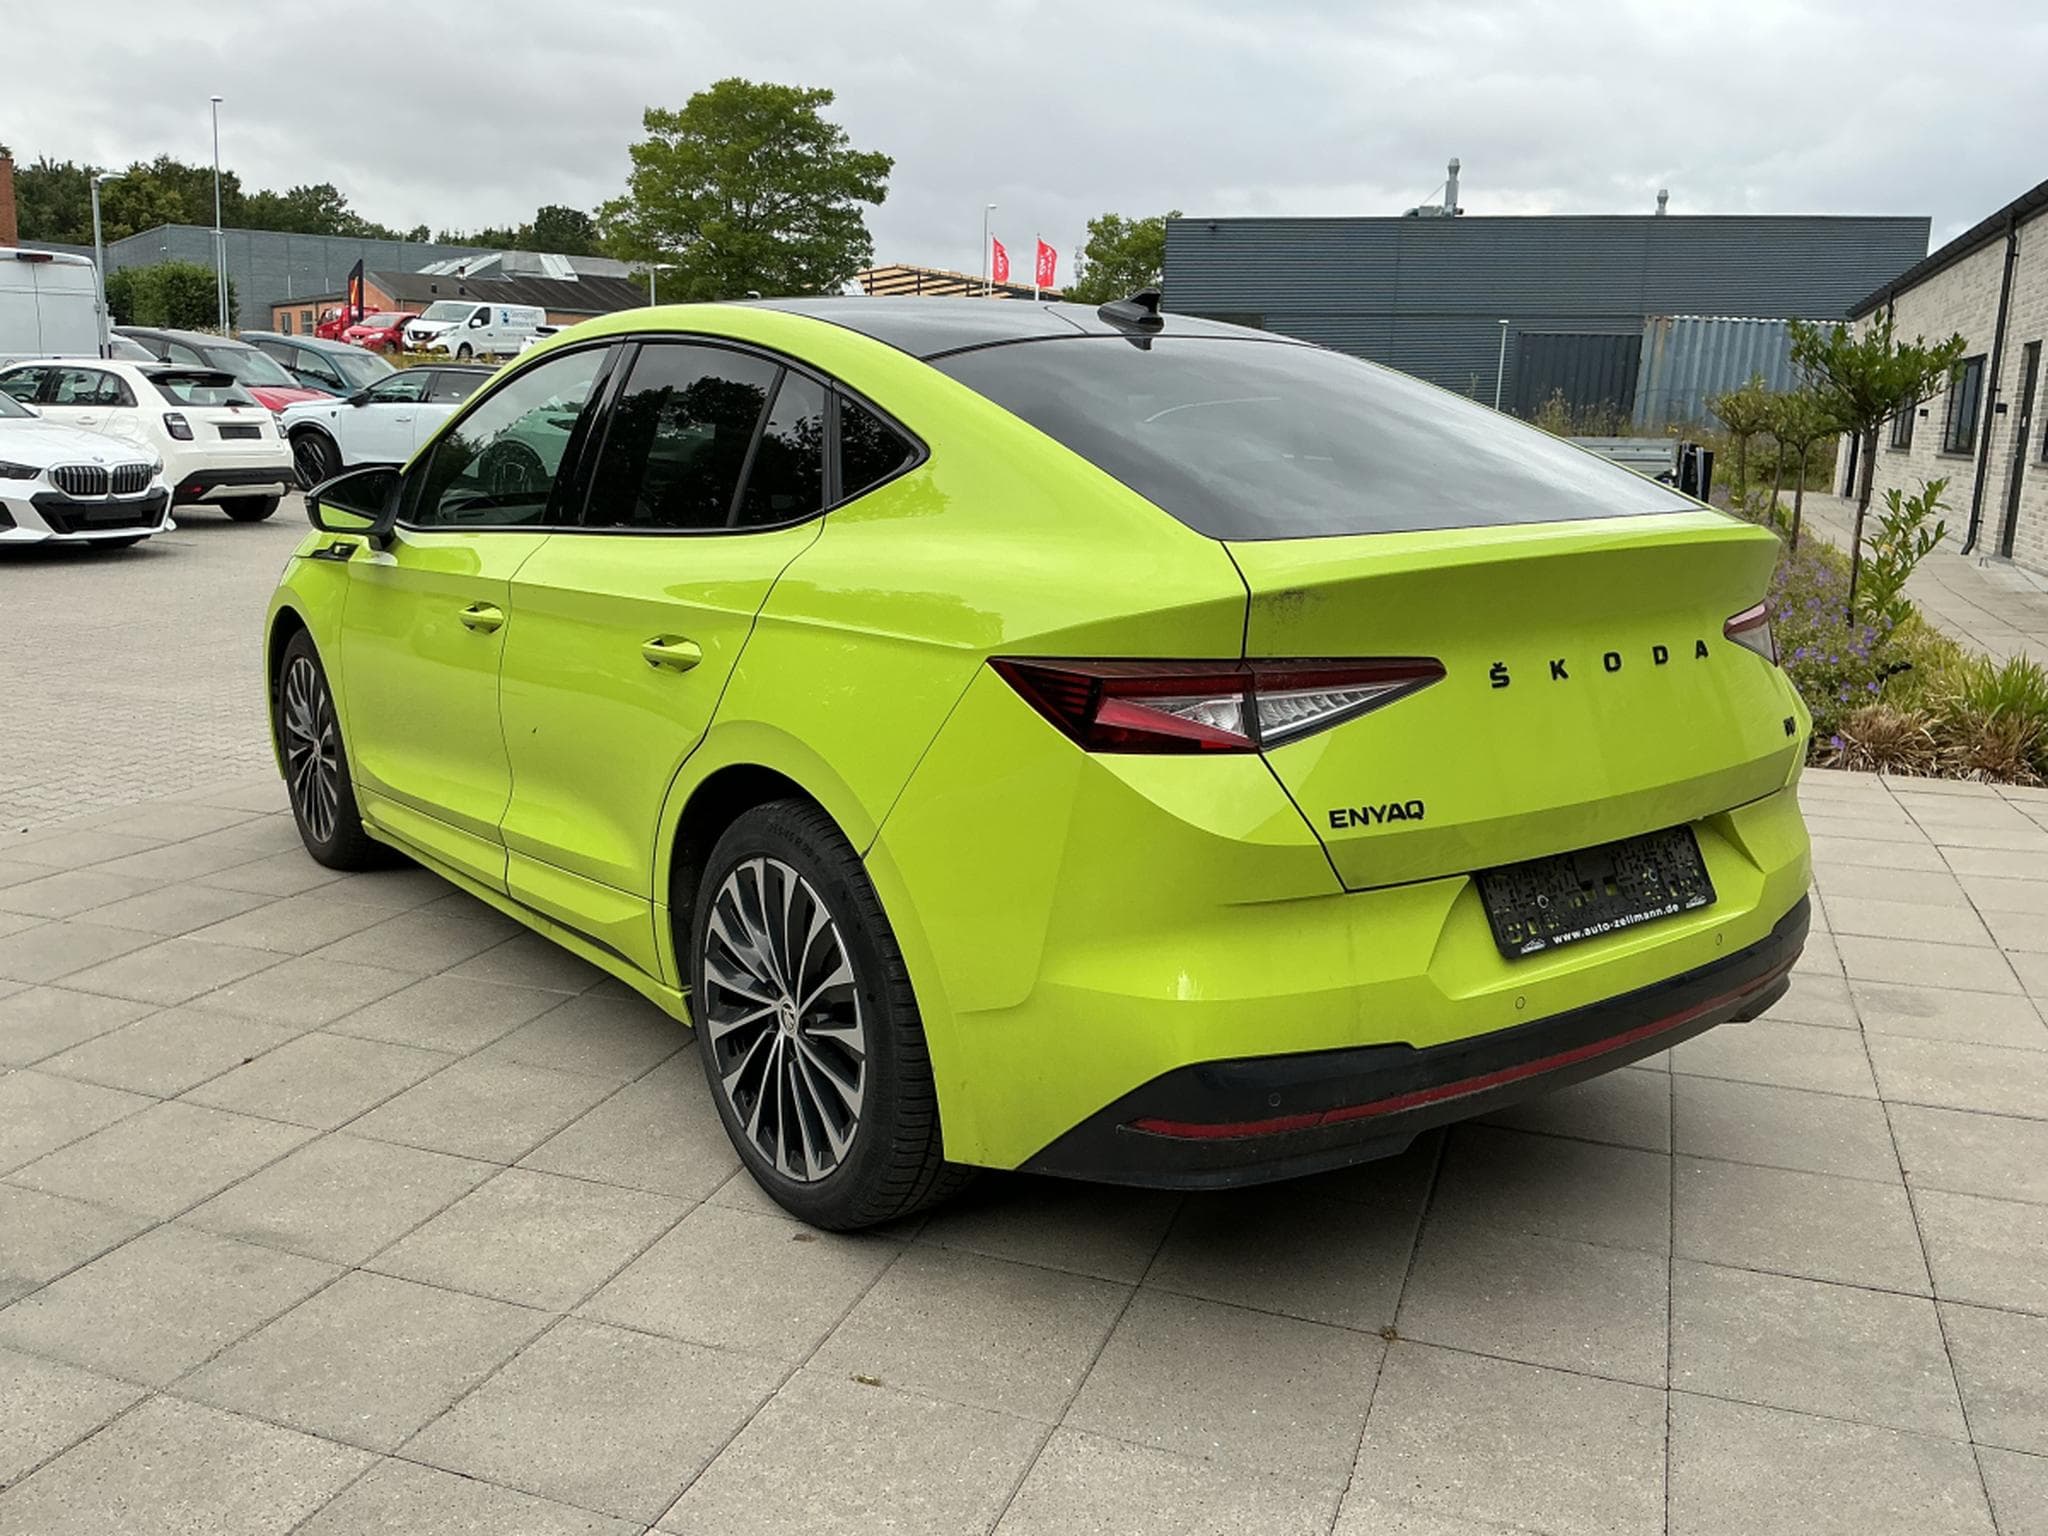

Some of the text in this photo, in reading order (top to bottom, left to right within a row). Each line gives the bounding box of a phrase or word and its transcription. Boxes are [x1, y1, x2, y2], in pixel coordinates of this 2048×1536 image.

[1489, 640, 1709, 689] ŠKODA
[1329, 800, 1424, 829] ENYAQ
[1552, 903, 1679, 944] www.auto-zellmann.de
